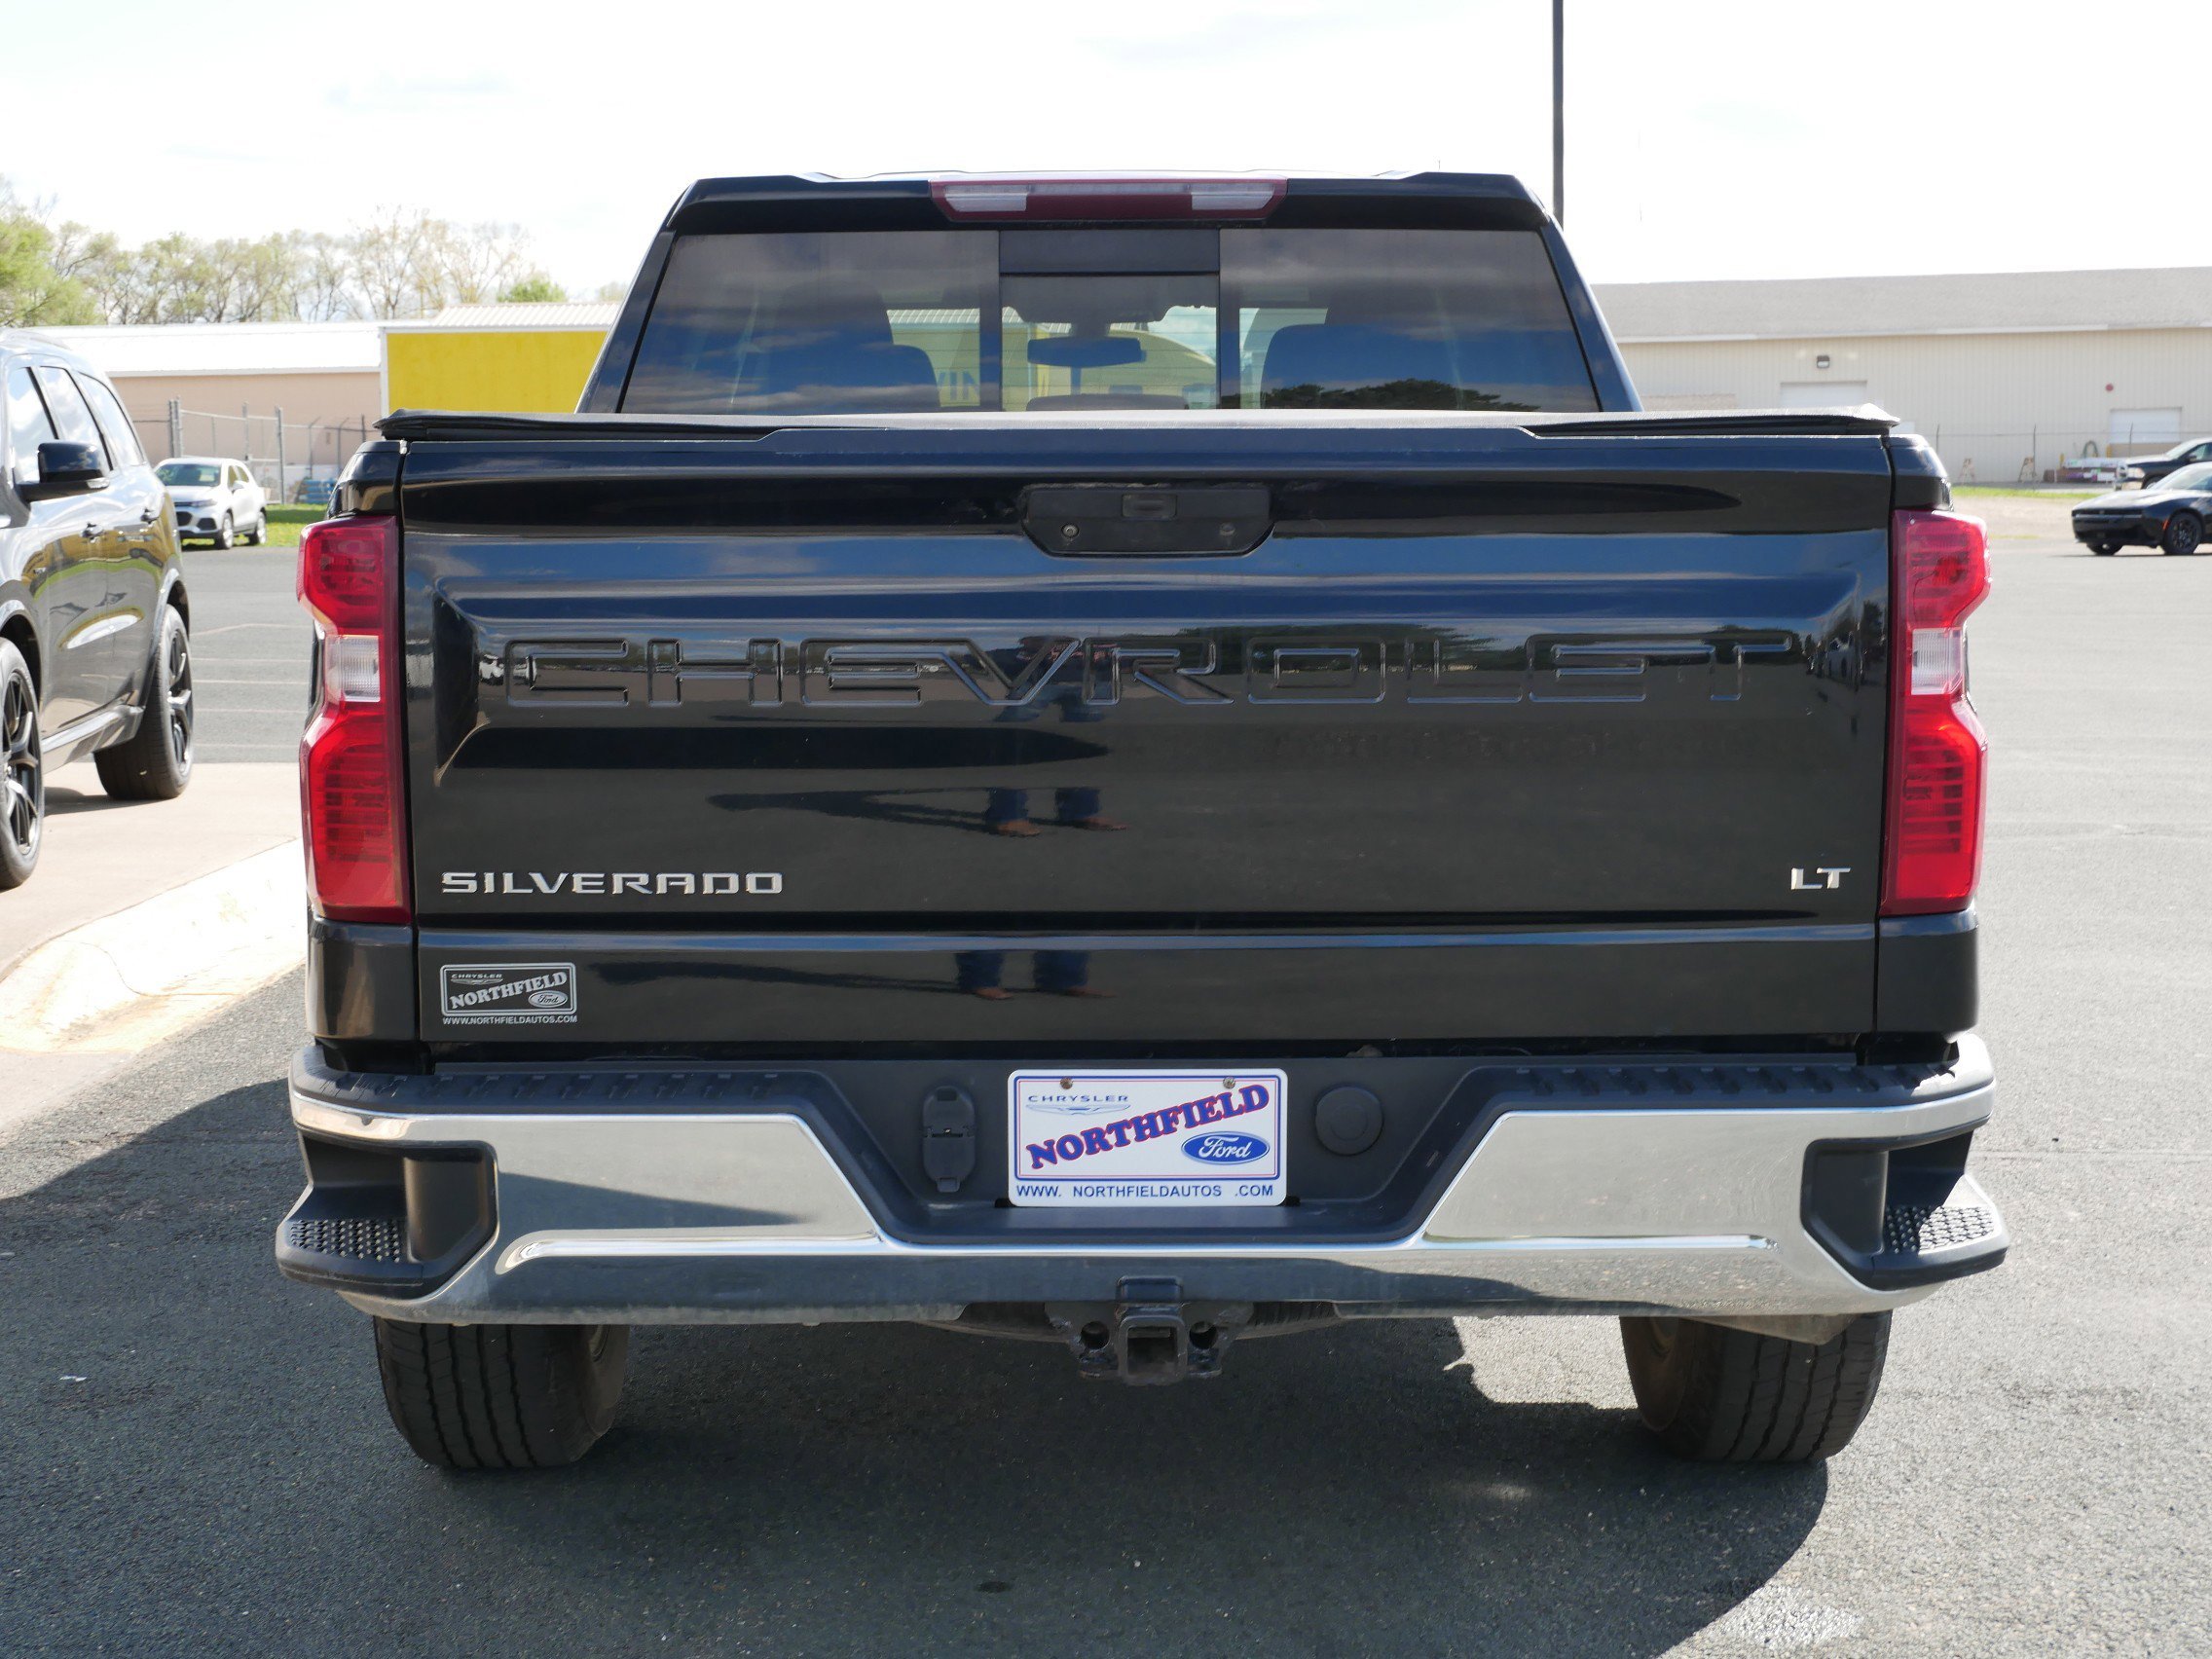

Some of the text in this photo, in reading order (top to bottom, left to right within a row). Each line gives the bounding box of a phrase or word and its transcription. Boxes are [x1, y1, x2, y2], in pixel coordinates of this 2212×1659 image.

[504, 636, 1792, 708] CHEVROLET
[441, 871, 783, 895] SILVERADO
[1790, 867, 1851, 890] LT
[450, 972, 568, 1010] NORTHFIELD
[537, 994, 560, 1004] Ford
[442, 1014, 578, 1025] WWW.NORTHFIELDAUTOS.COM
[1025, 1084, 1270, 1169] NORTHFIELD
[1198, 1136, 1251, 1159] Ford
[1015, 1184, 1273, 1198] WWW. NORTHFIELDAUTOS .COM
